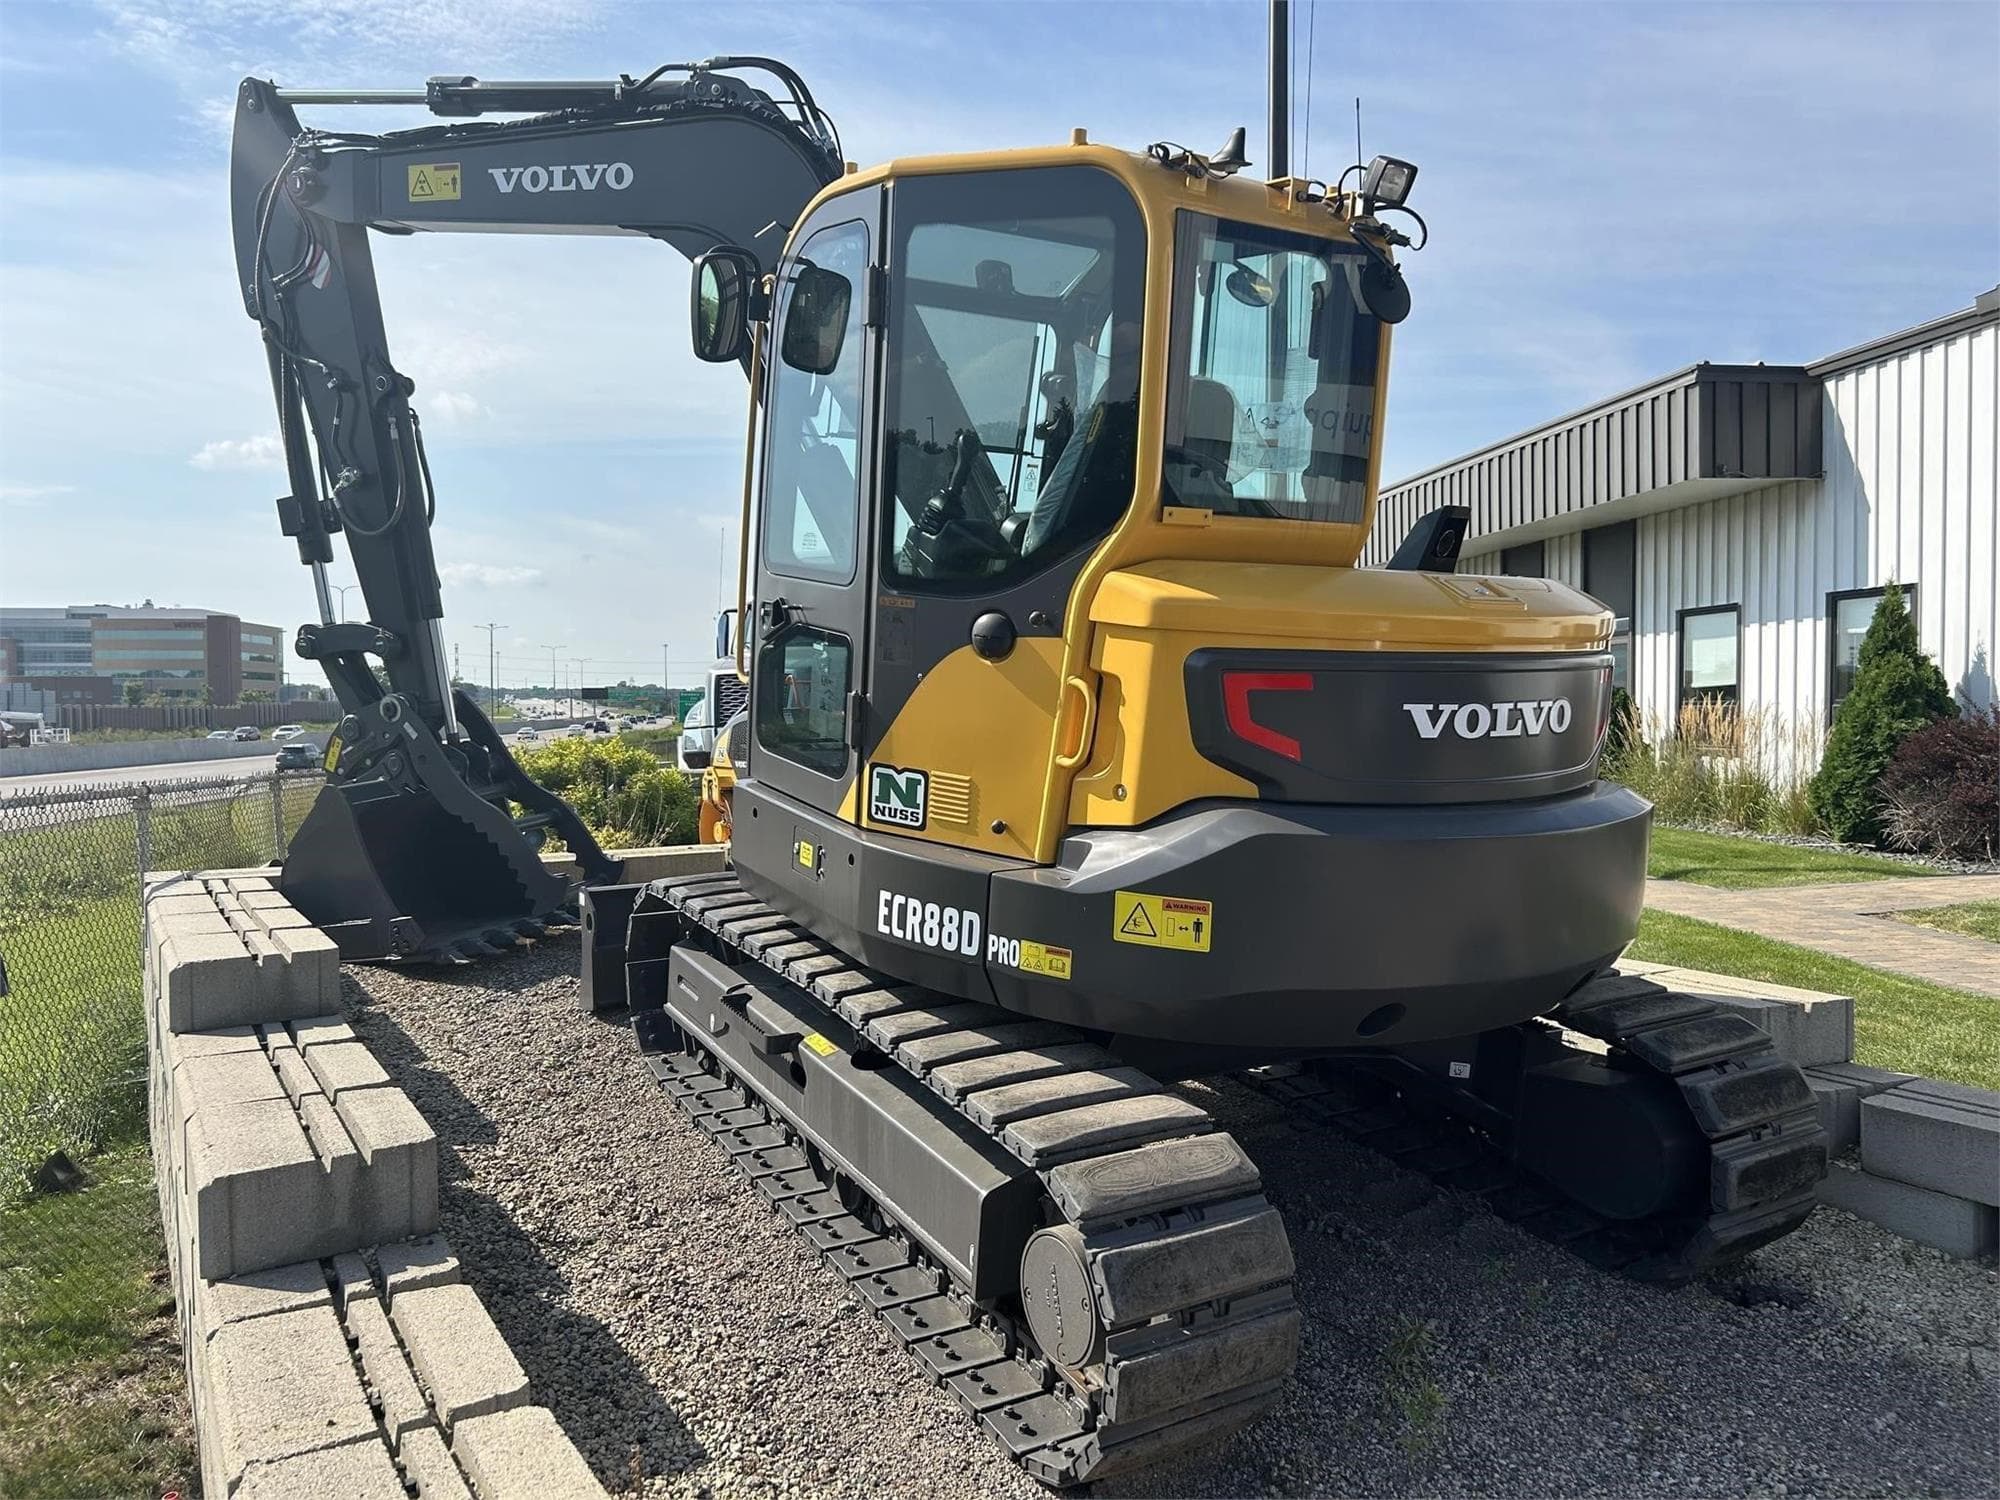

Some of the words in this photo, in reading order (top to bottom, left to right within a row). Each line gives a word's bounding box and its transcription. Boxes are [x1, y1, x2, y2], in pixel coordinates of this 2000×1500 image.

[488, 162, 634, 193] VOLVO
[1403, 699, 1572, 739] VOLVO
[875, 771, 922, 810] N
[874, 804, 920, 823] NUSS
[1173, 902, 1207, 912] WARNING
[877, 889, 981, 957] ECR88D
[987, 933, 1020, 968] PRO
